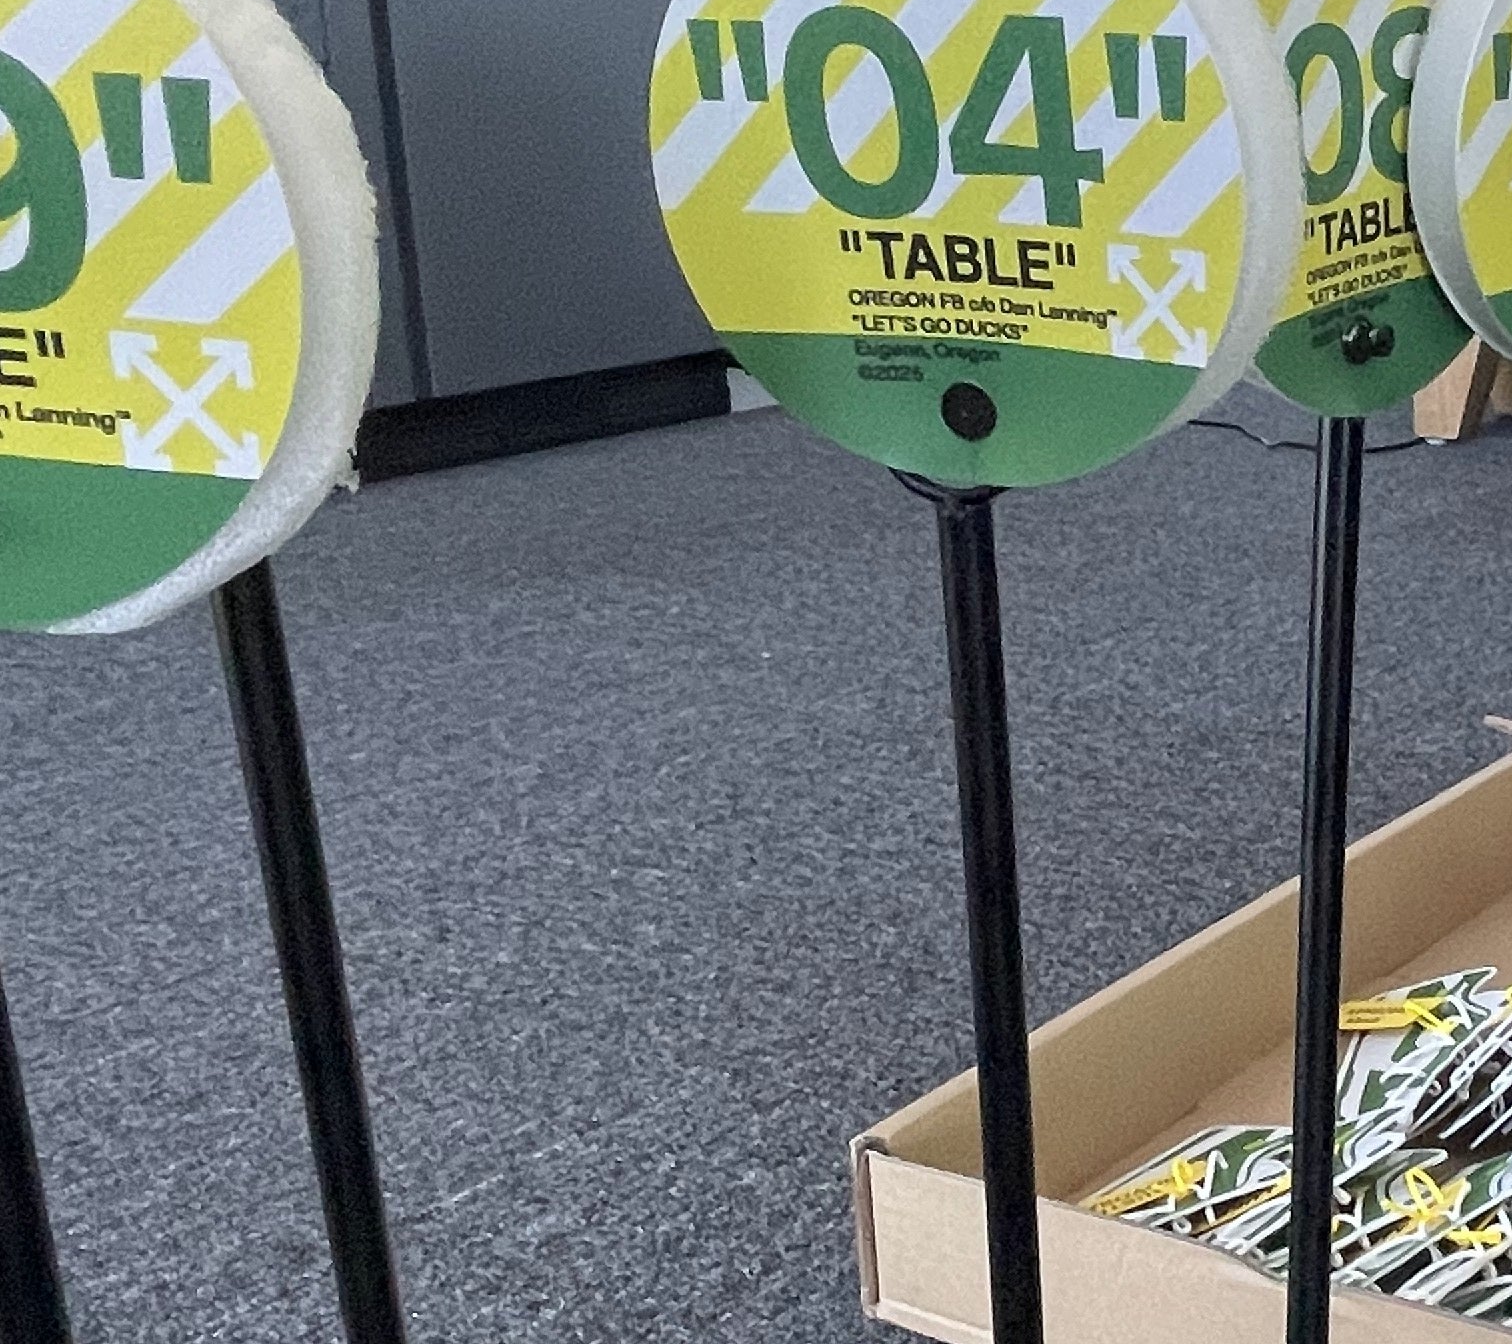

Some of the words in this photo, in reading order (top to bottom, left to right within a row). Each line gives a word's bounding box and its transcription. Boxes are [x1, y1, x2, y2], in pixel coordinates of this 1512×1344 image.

[686, 4, 1188, 229] "04"
[839, 229, 1076, 290] "TABLE"
[849, 289, 935, 309] OREGON
[940, 292, 965, 311] FB
[1000, 297, 1034, 316] Dan
[920, 316, 951, 335] GO
[955, 318, 1028, 341] DUCKS"
